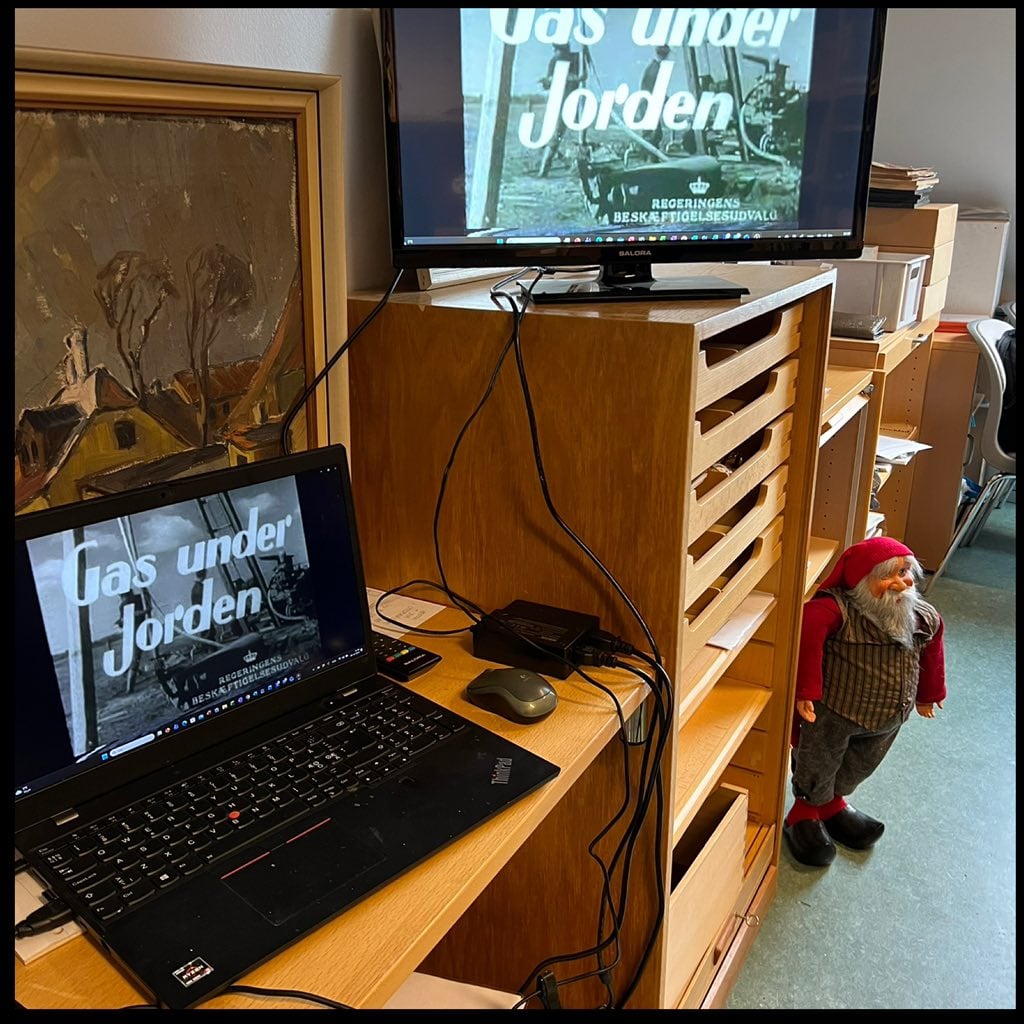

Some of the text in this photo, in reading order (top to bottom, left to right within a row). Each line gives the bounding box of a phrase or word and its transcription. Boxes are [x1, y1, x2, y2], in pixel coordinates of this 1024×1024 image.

[631, 8, 801, 47] under
[517, 60, 734, 149] Jorden
[651, 198, 740, 210] REGERINGENS
[61, 507, 293, 607] Gas under
[103, 578, 262, 678] Jorden
[218, 655, 283, 685] REGERINGENS
